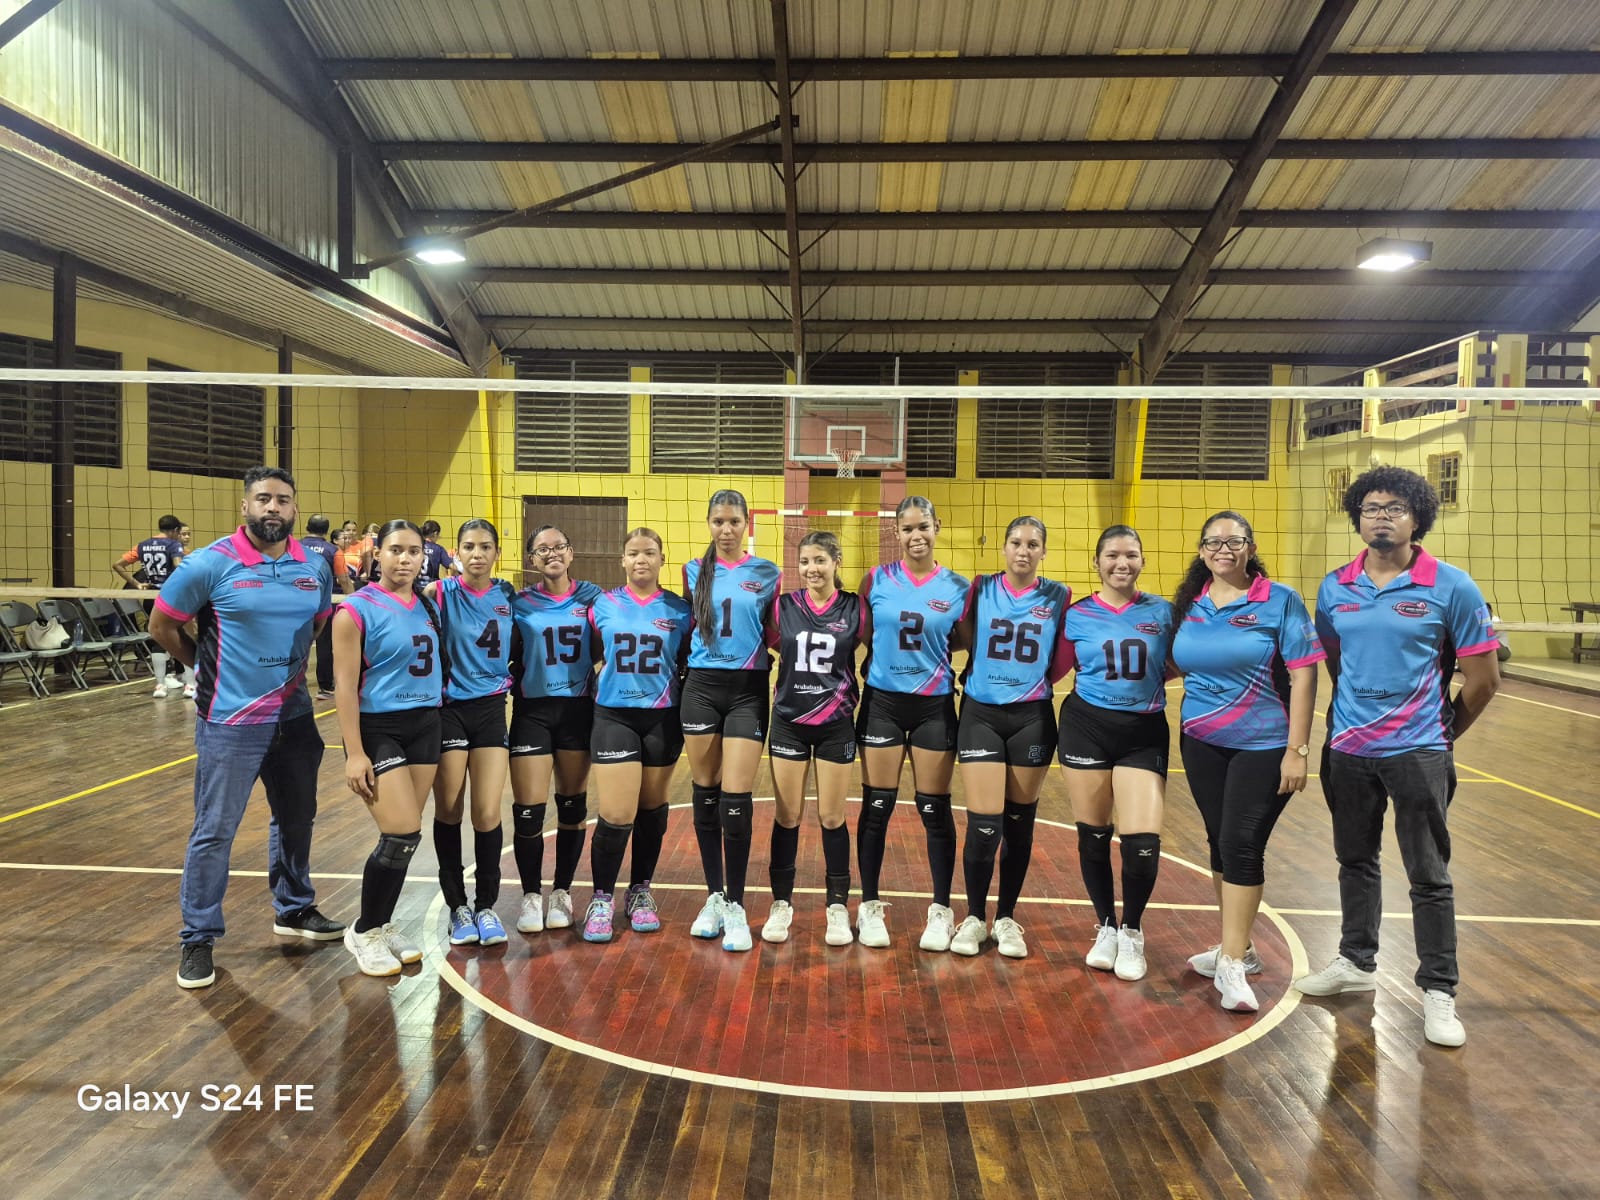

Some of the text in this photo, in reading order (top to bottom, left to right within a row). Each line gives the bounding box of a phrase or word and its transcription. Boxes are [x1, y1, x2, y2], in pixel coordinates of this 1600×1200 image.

[143, 552, 167, 576] 22
[476, 619, 500, 659] 4
[719, 598, 732, 638] 1
[899, 611, 925, 651] 2
[408, 634, 434, 678] 3
[542, 624, 582, 666] 15
[614, 632, 663, 674] 22
[794, 631, 836, 674] 12
[987, 618, 1042, 664] 26
[1102, 638, 1148, 681] 10
[793, 683, 823, 691] Arubabank
